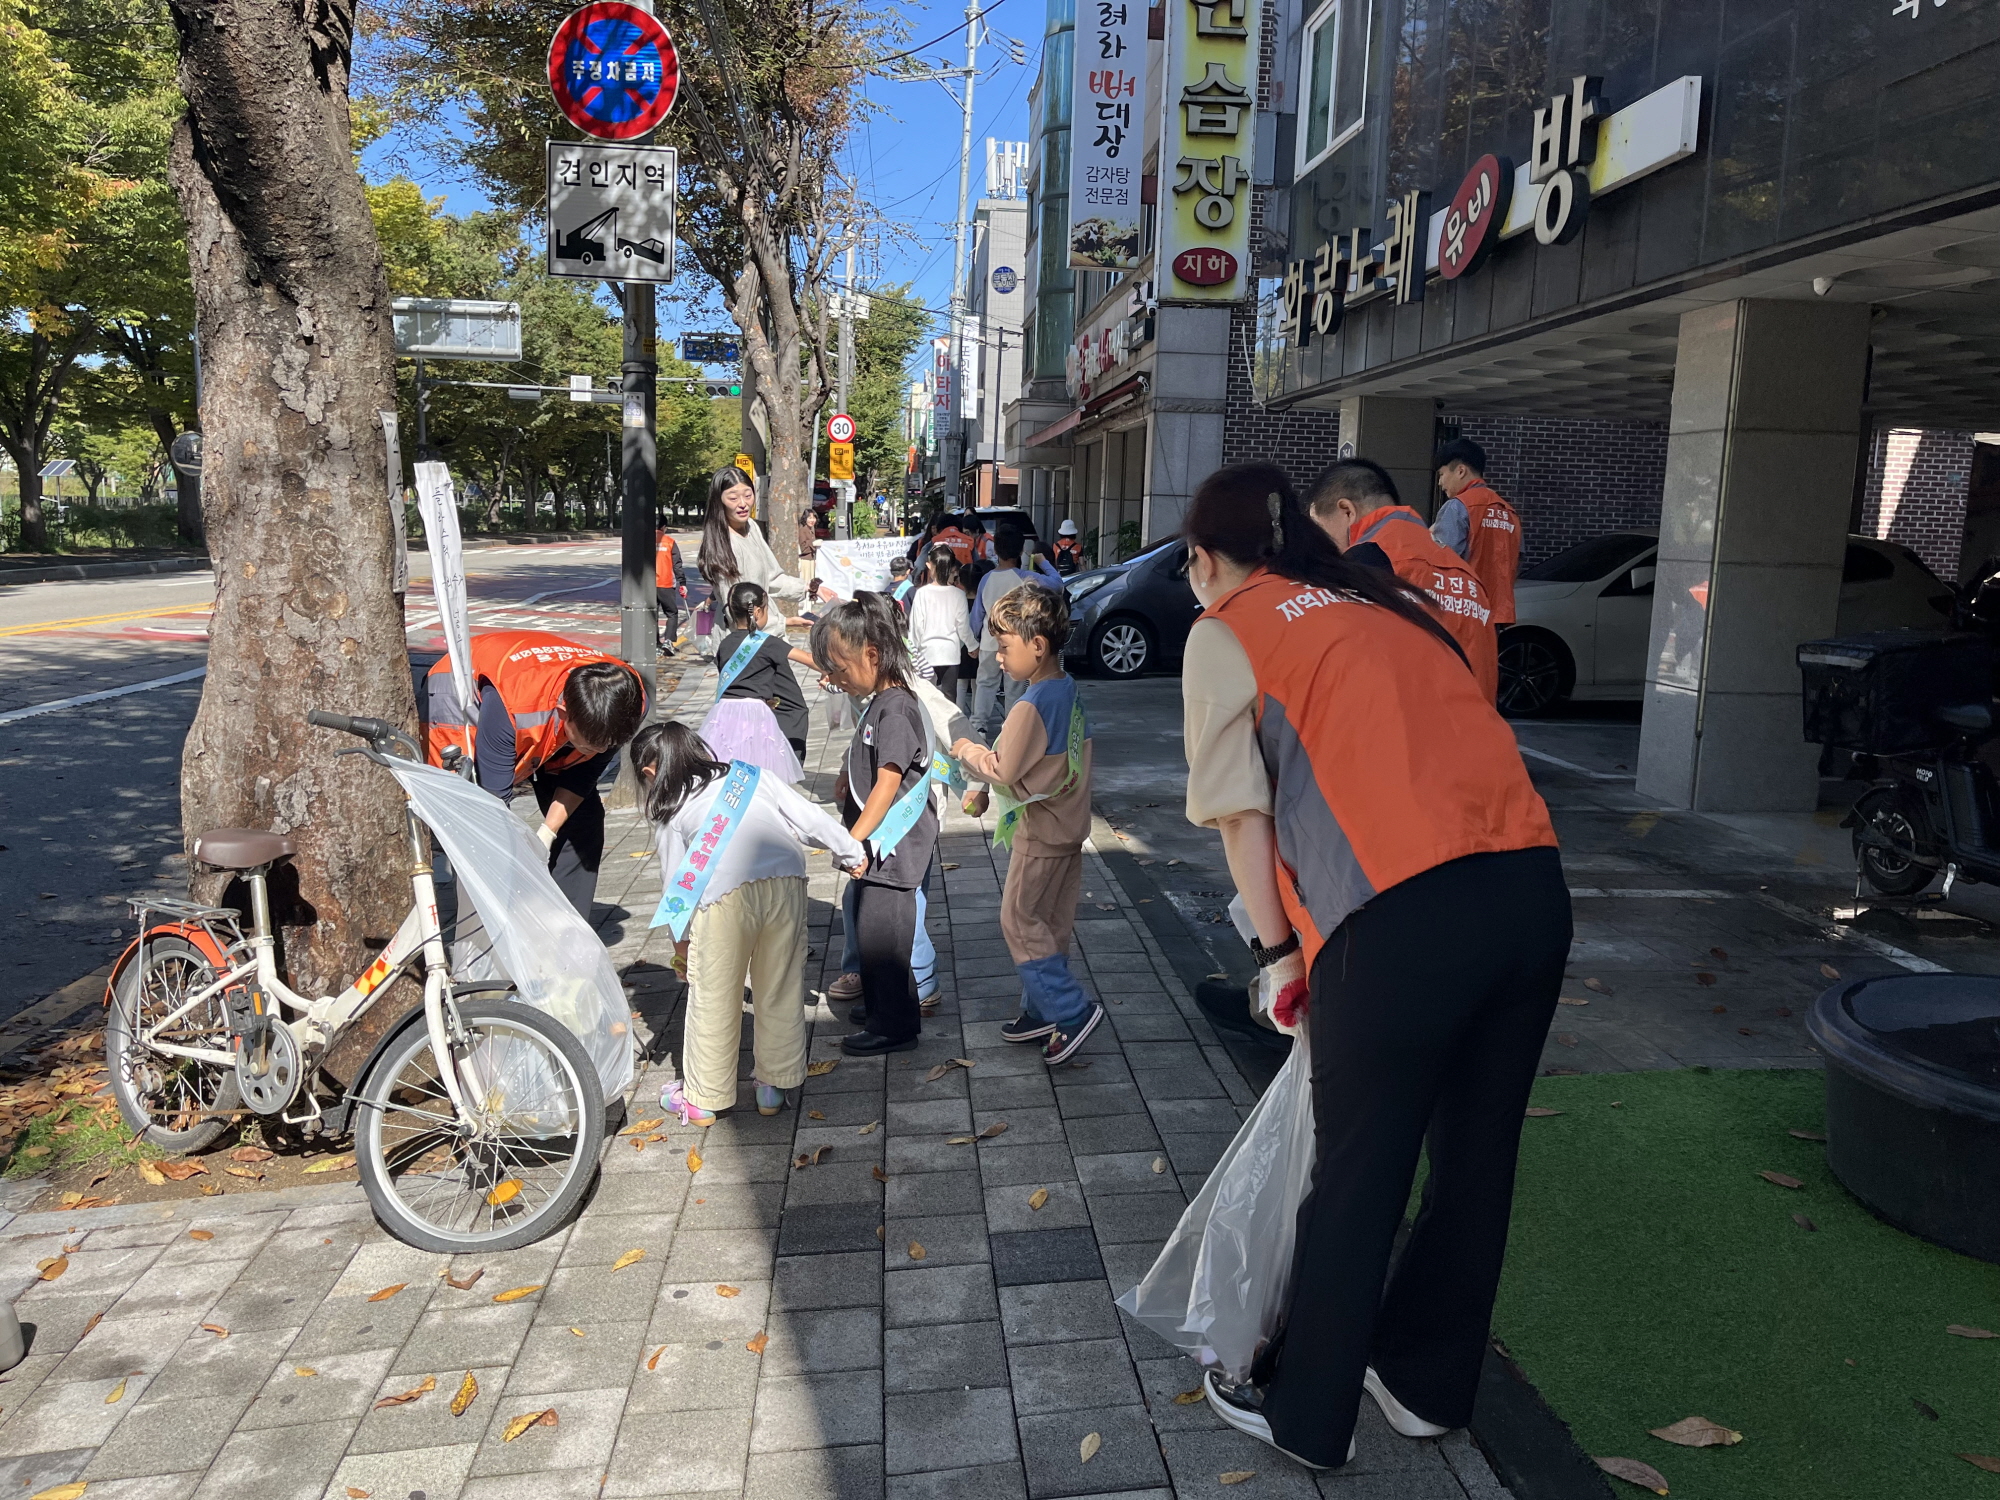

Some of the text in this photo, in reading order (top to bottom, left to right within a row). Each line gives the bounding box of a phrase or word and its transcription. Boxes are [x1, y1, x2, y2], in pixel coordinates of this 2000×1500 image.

[572, 60, 655, 82] 주정차금지
[559, 158, 666, 191] 견인지역
[1085, 165, 1131, 184] 감자탕
[1085, 187, 1129, 205] 전문점
[1279, 75, 1595, 348] 화랑노래 유비 방
[1182, 254, 1230, 278] 지하
[993, 274, 1015, 287] 부동산
[833, 422, 850, 435] 30
[1432, 572, 1478, 598] 고잔동
[723, 767, 750, 810] 다함께
[677, 813, 731, 891] 실천해요
